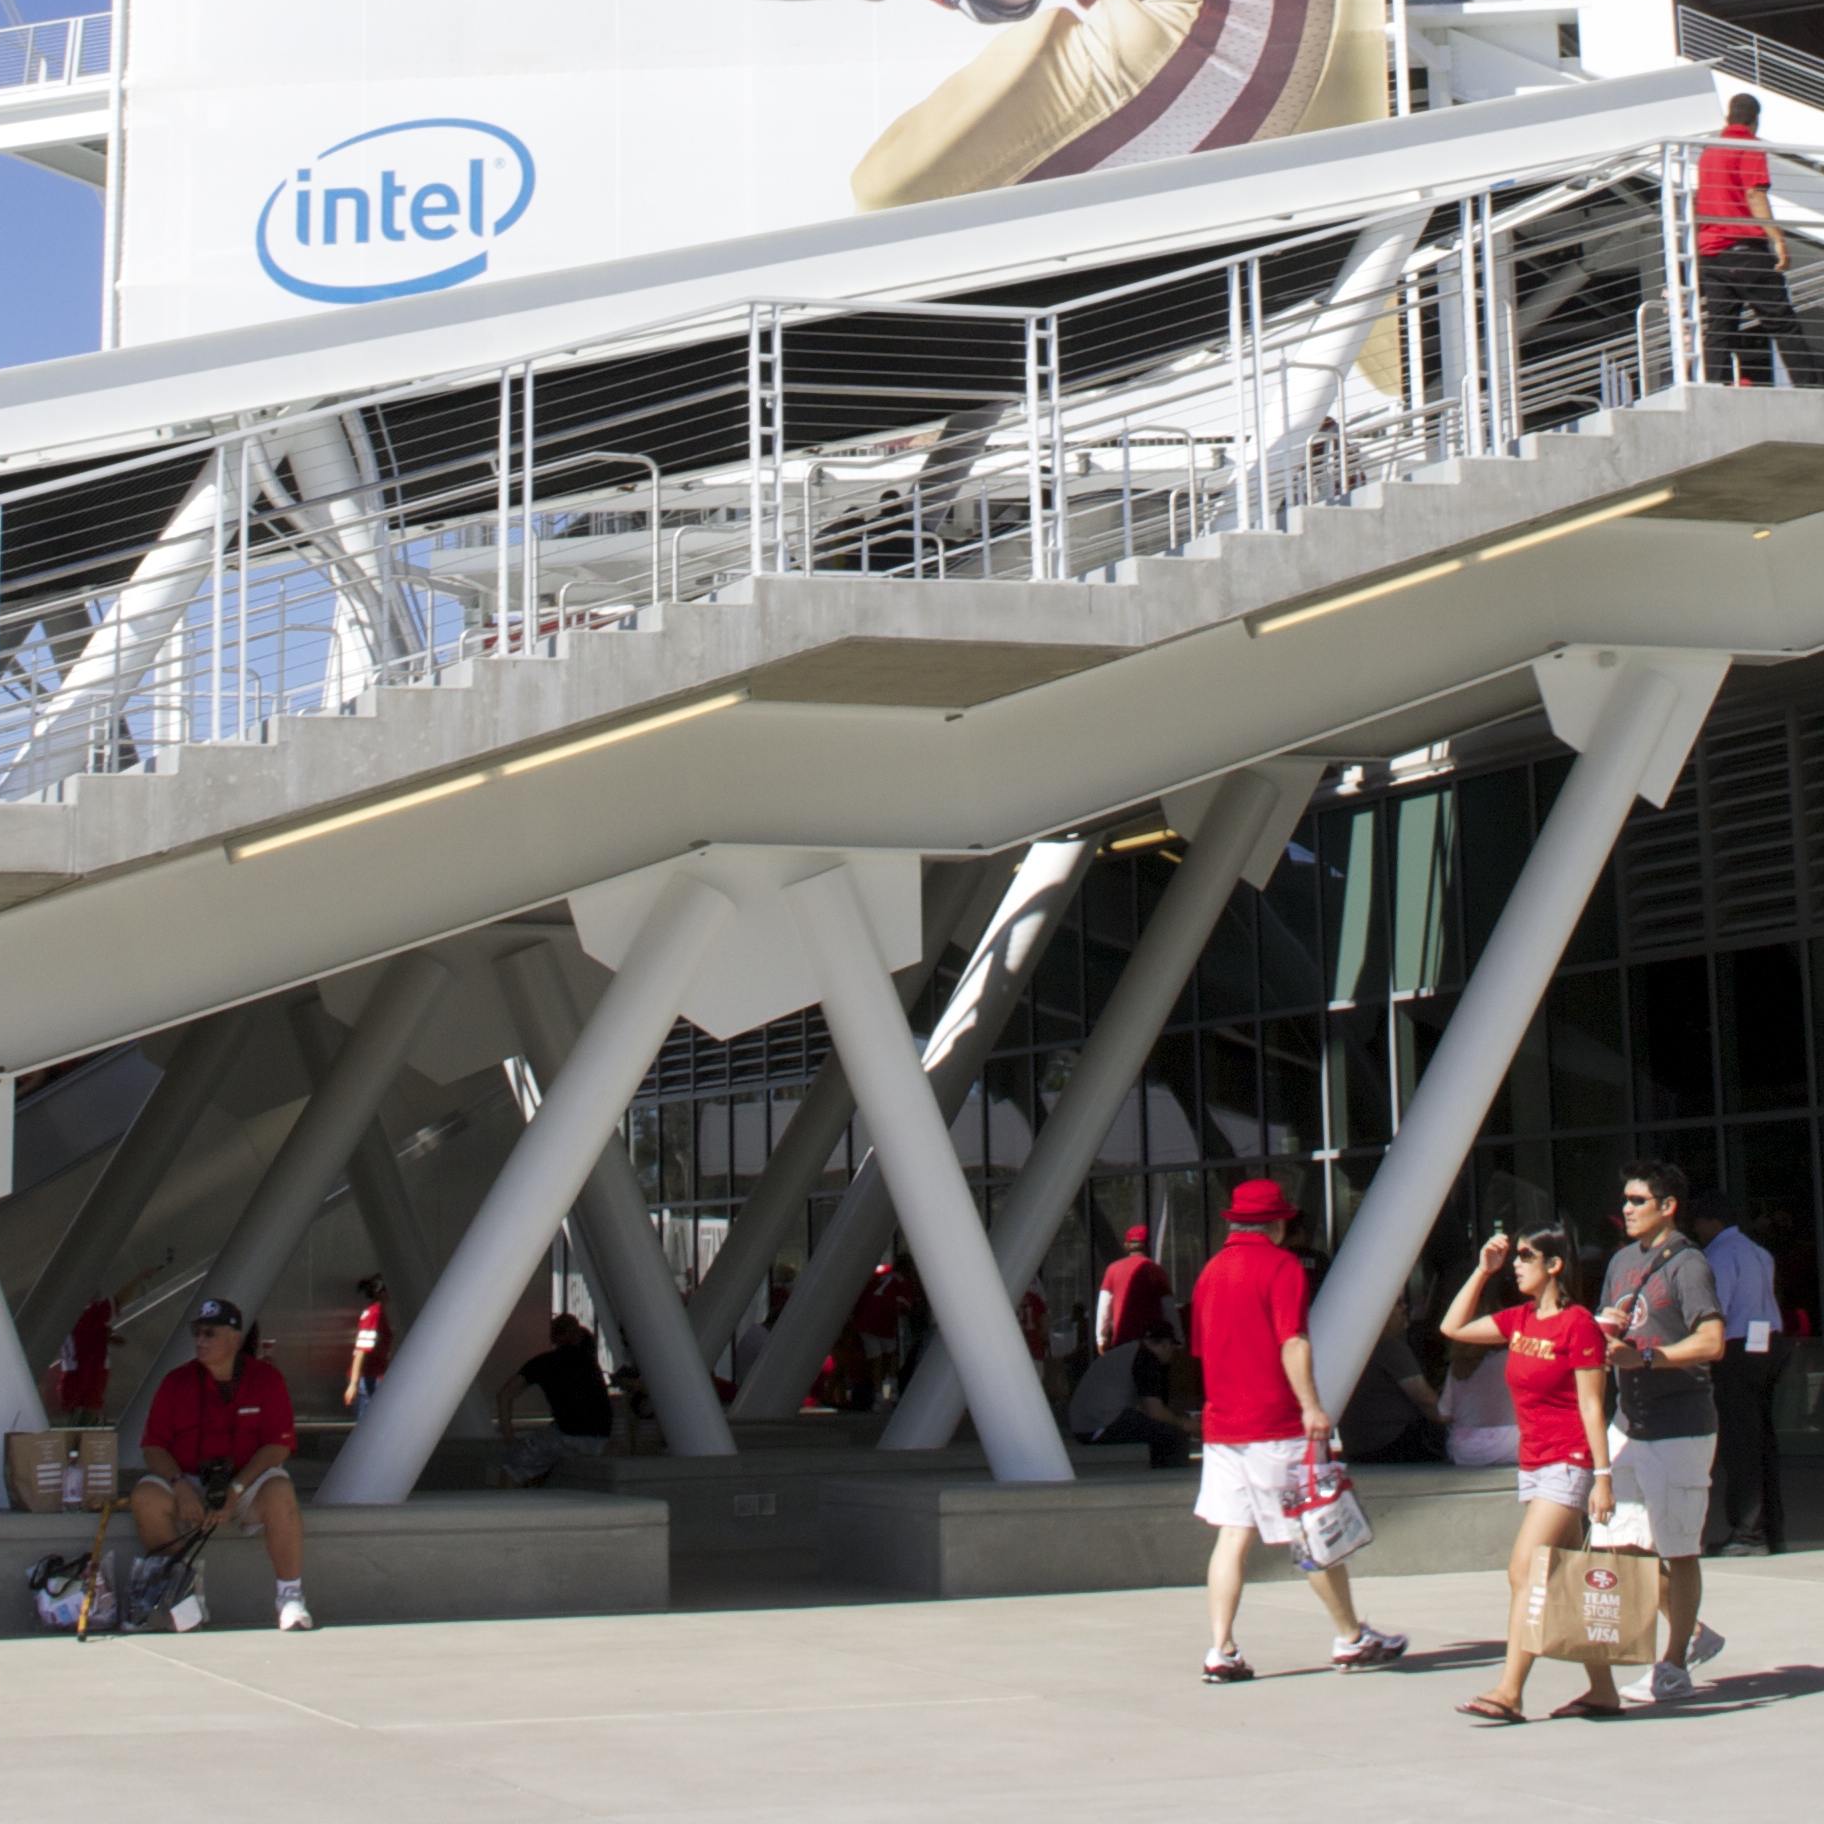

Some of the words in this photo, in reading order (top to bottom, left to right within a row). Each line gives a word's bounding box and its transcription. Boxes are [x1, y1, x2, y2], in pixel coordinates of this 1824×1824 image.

[295, 158, 485, 247] intel
[1583, 1591, 1621, 1607] TEAM
[1583, 1604, 1621, 1619] STORE
[1585, 1626, 1620, 1644] VISA
